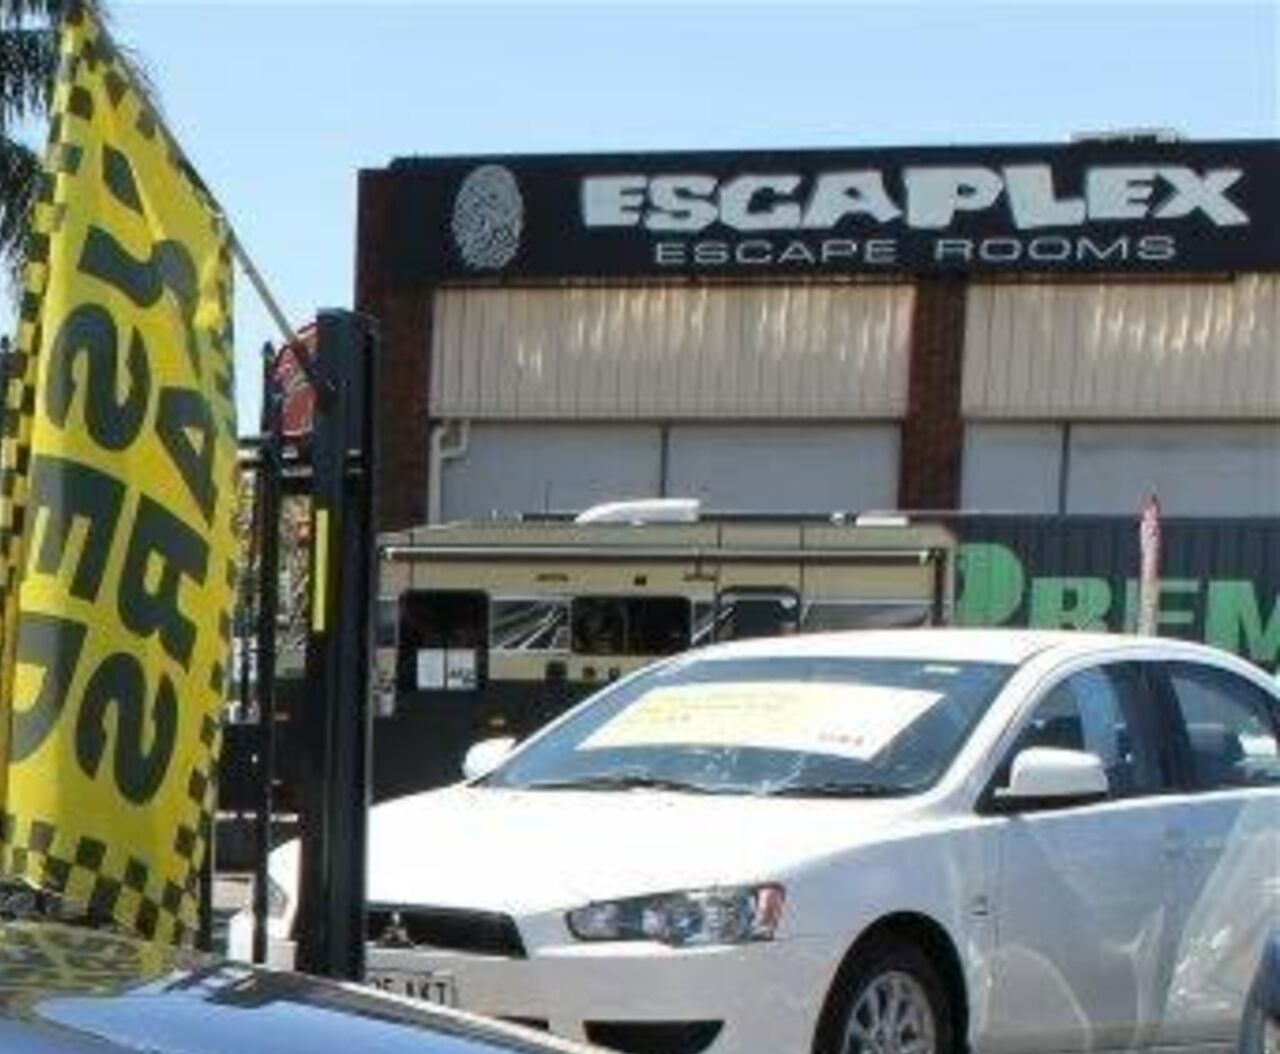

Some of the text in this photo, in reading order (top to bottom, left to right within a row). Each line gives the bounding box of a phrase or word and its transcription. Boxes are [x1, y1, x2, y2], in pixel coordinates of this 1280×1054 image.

[581, 164, 1250, 231] ESCAPLEX
[654, 235, 1178, 266] ESCAPE ROOMS
